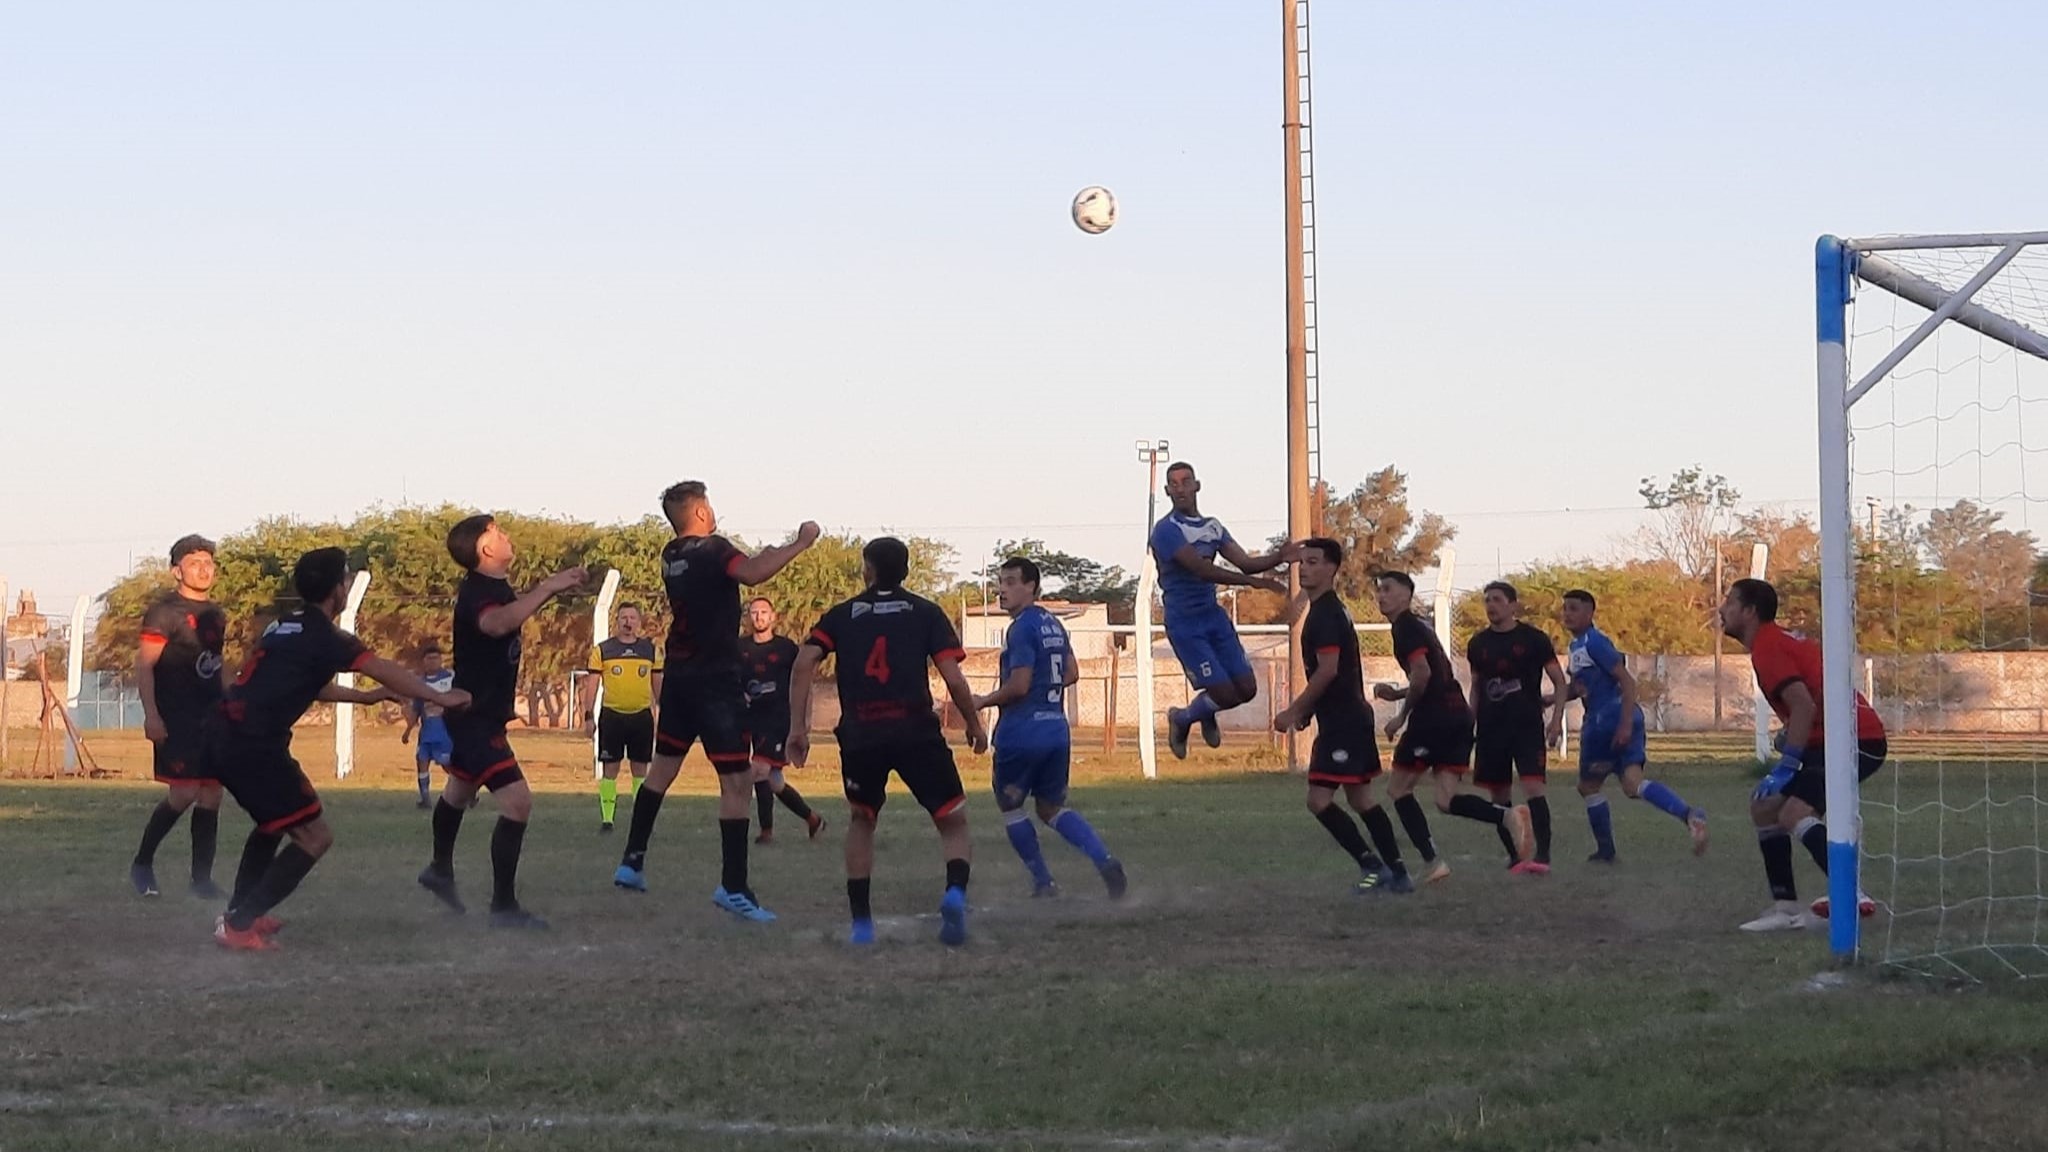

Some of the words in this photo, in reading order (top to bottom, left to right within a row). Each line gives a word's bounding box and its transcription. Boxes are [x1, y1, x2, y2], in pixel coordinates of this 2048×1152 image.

[865, 635, 891, 684] 4
[1048, 653, 1063, 702] 5
[1200, 661, 1212, 677] 6
